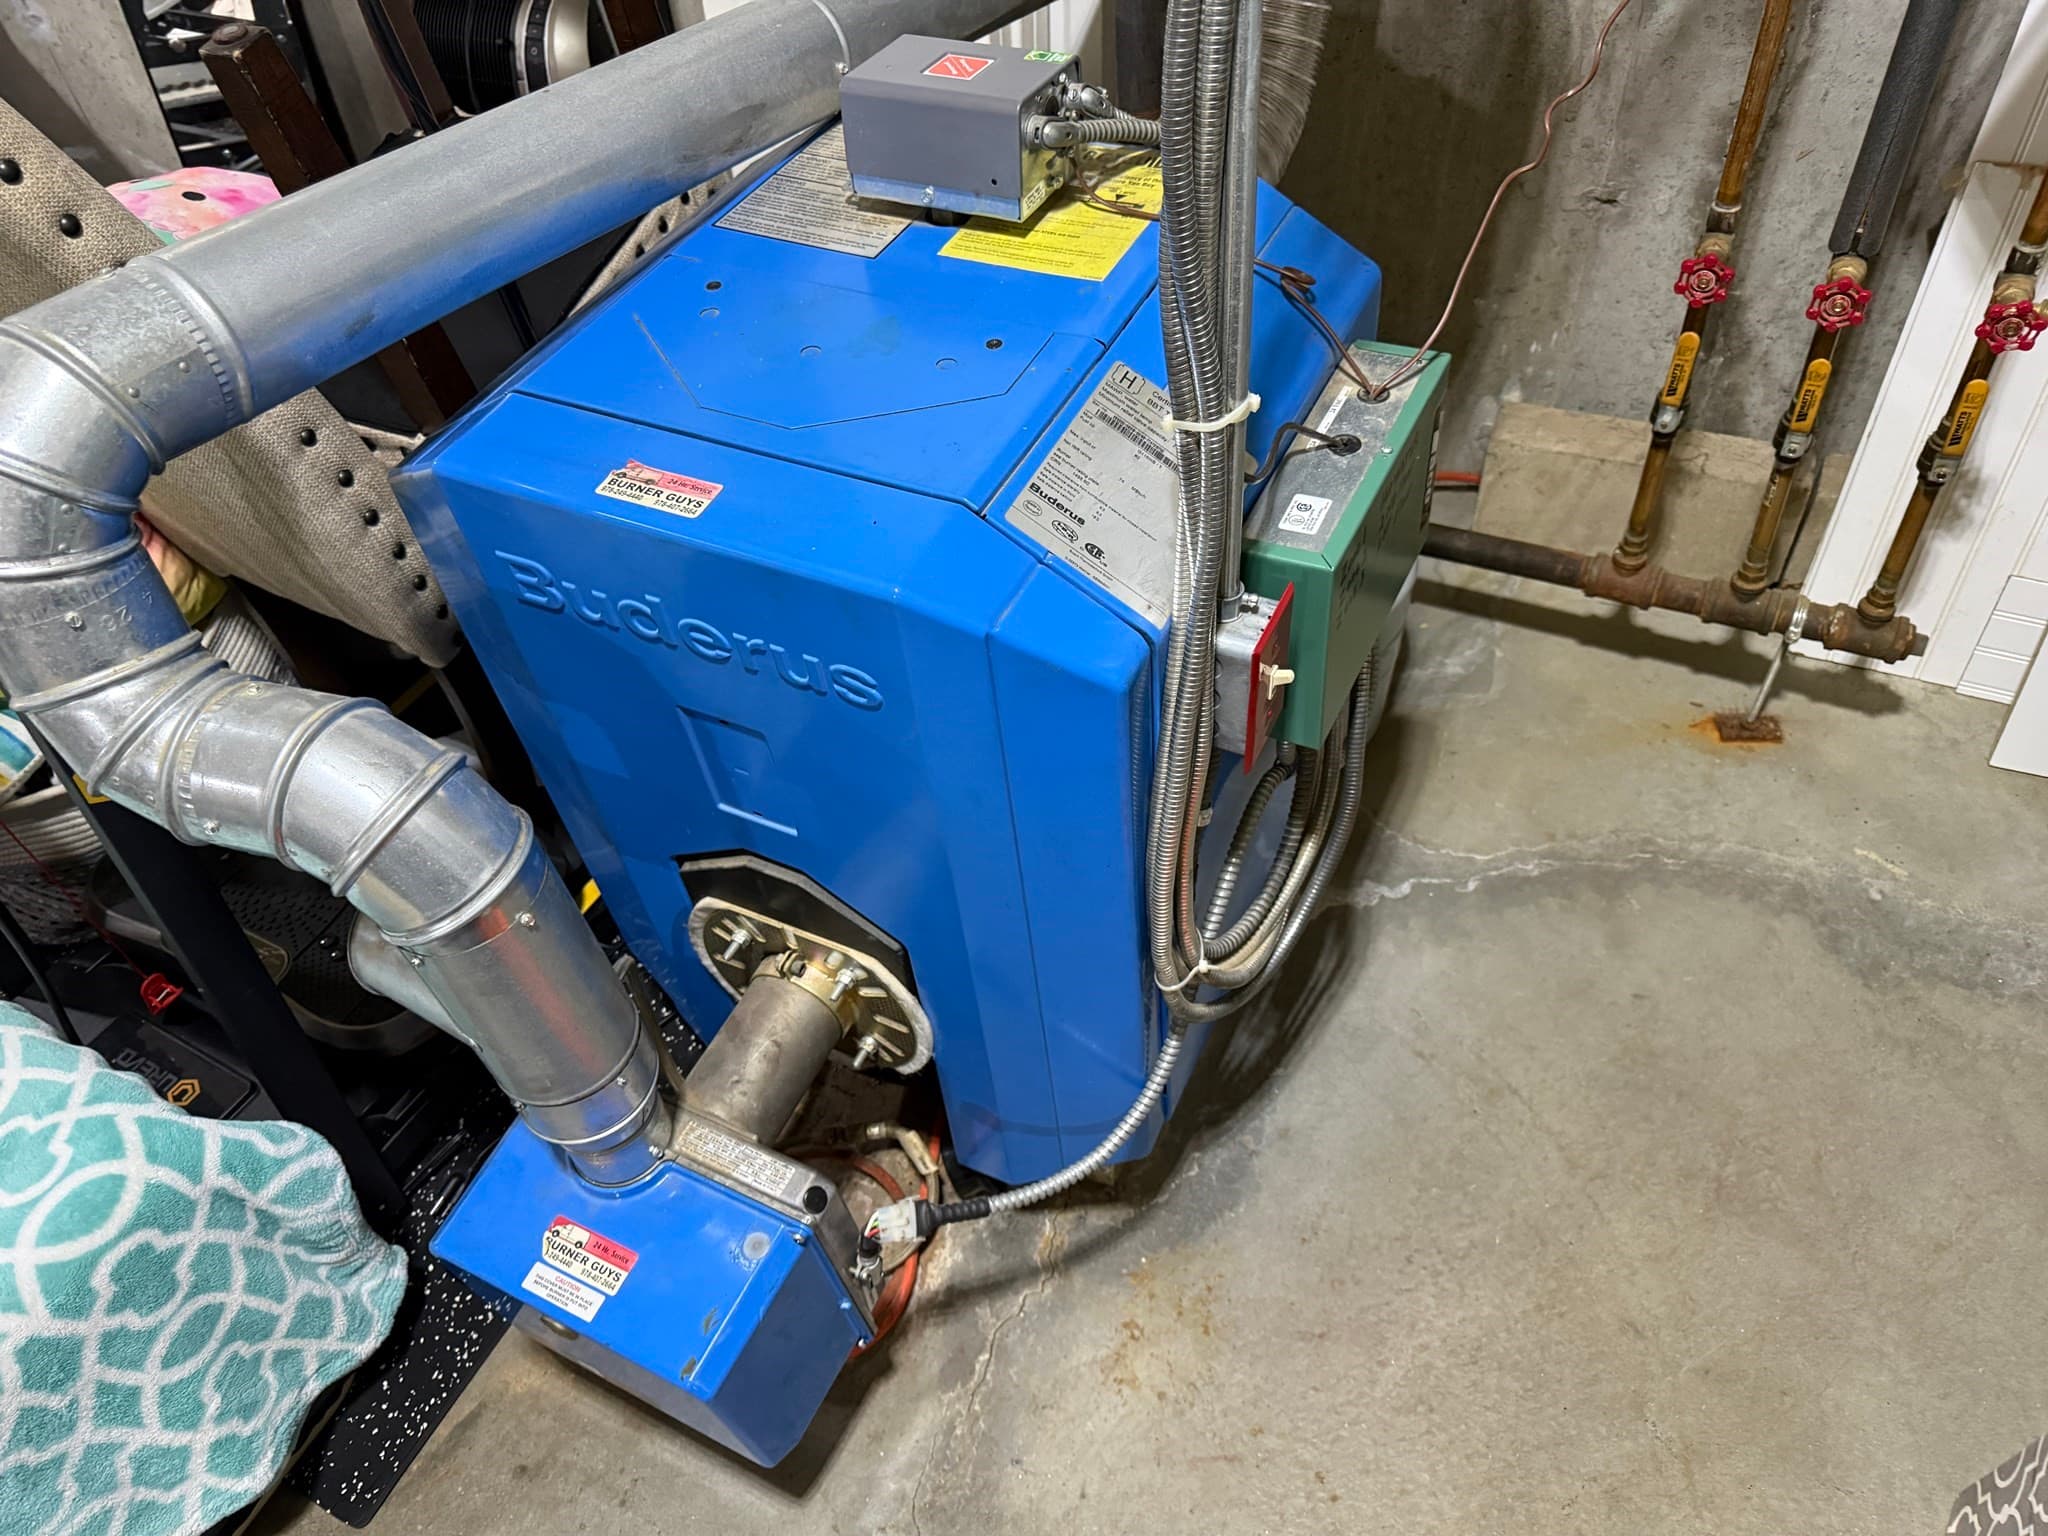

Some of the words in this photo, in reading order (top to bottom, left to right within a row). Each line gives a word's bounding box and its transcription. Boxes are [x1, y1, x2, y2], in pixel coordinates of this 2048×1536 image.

[1119, 370, 1136, 388] H
[608, 477, 662, 497] BURNER
[666, 492, 703, 508] GUYS
[1028, 482, 1087, 525] Buderus
[494, 549, 884, 711] Buderus
[593, 1241, 601, 1249] 24
[610, 1250, 629, 1264] Service
[590, 1261, 621, 1282] GUYS
[555, 1275, 580, 1292] CAUTION
